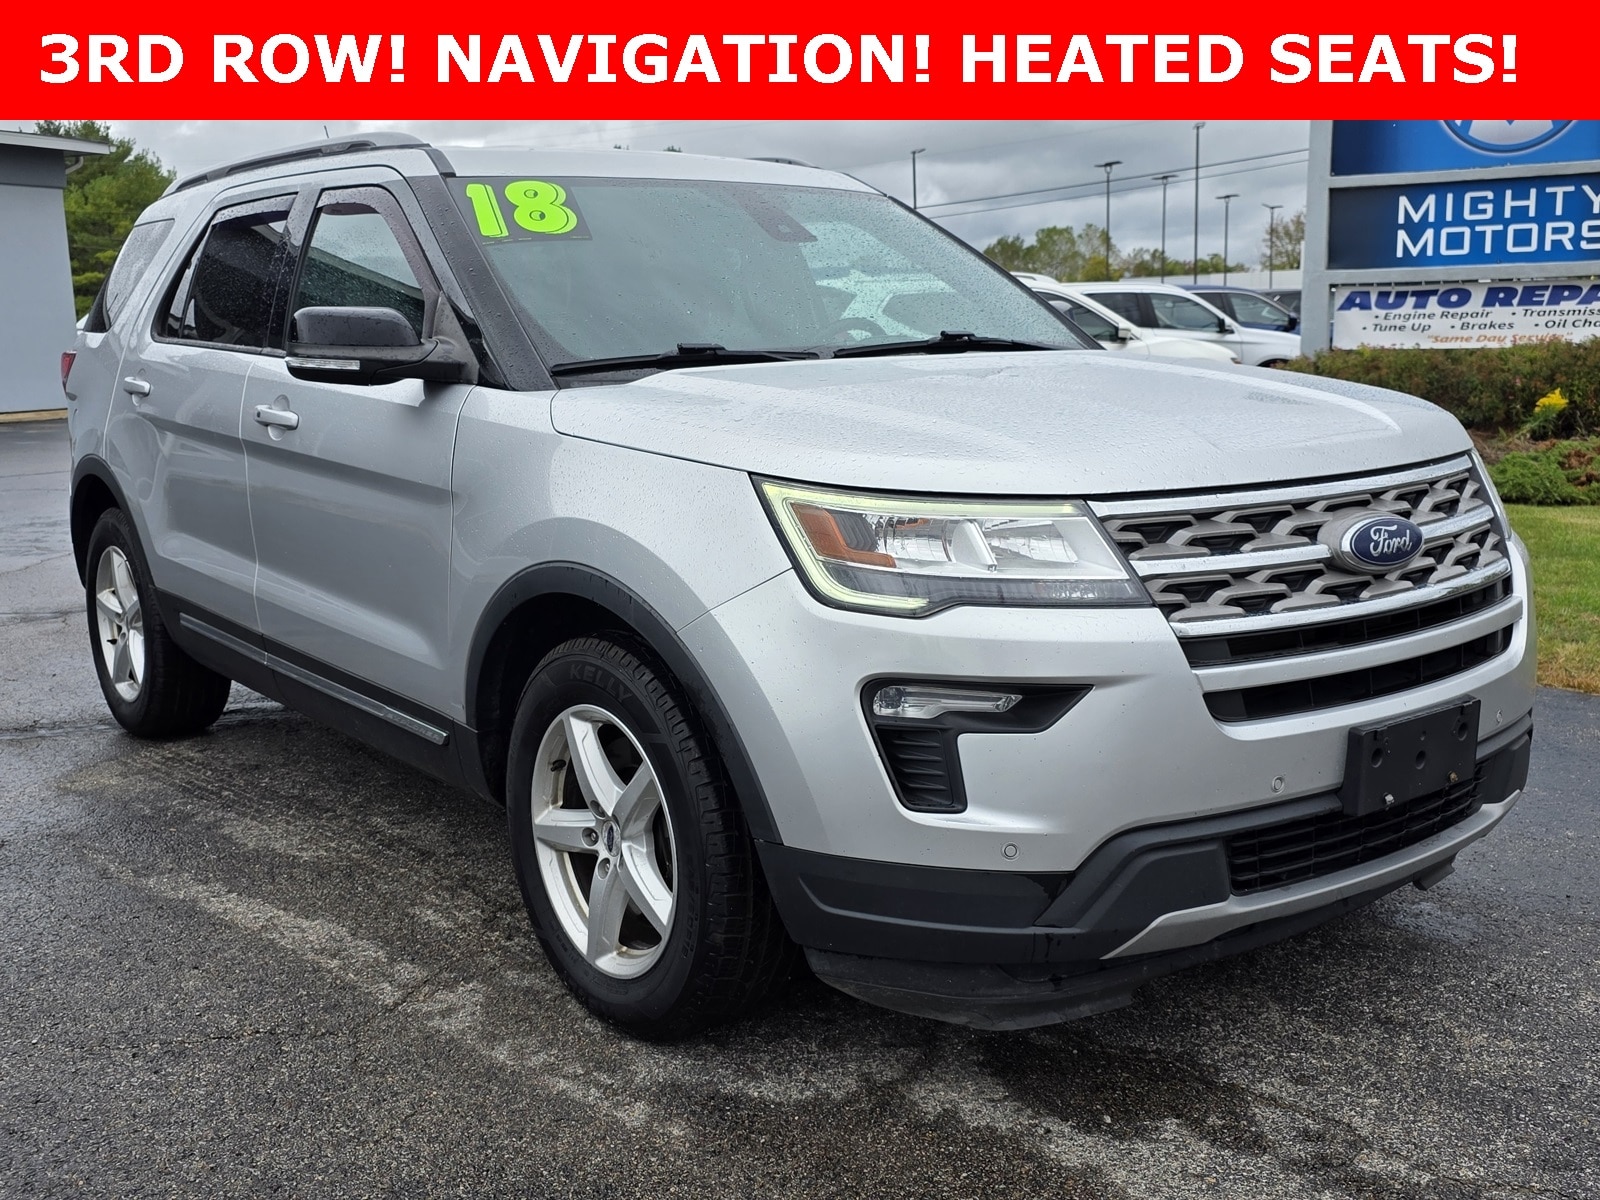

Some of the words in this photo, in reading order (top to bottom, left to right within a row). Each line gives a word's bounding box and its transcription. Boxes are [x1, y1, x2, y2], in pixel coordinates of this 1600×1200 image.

[466, 180, 578, 237] 18
[1398, 185, 1600, 224] MIGHTY
[1396, 220, 1600, 258] MOTORS
[1337, 288, 1472, 311] AUTO
[1383, 312, 1436, 322] Engine
[1440, 309, 1493, 320] Repair
[1372, 323, 1406, 332] Tune
[1411, 323, 1431, 333] Up
[1460, 321, 1515, 331] Brakes
[1544, 319, 1567, 328] Oil
[1476, 334, 1507, 344] Day
[1370, 525, 1412, 557] Ford
[569, 663, 634, 702] KELLY
